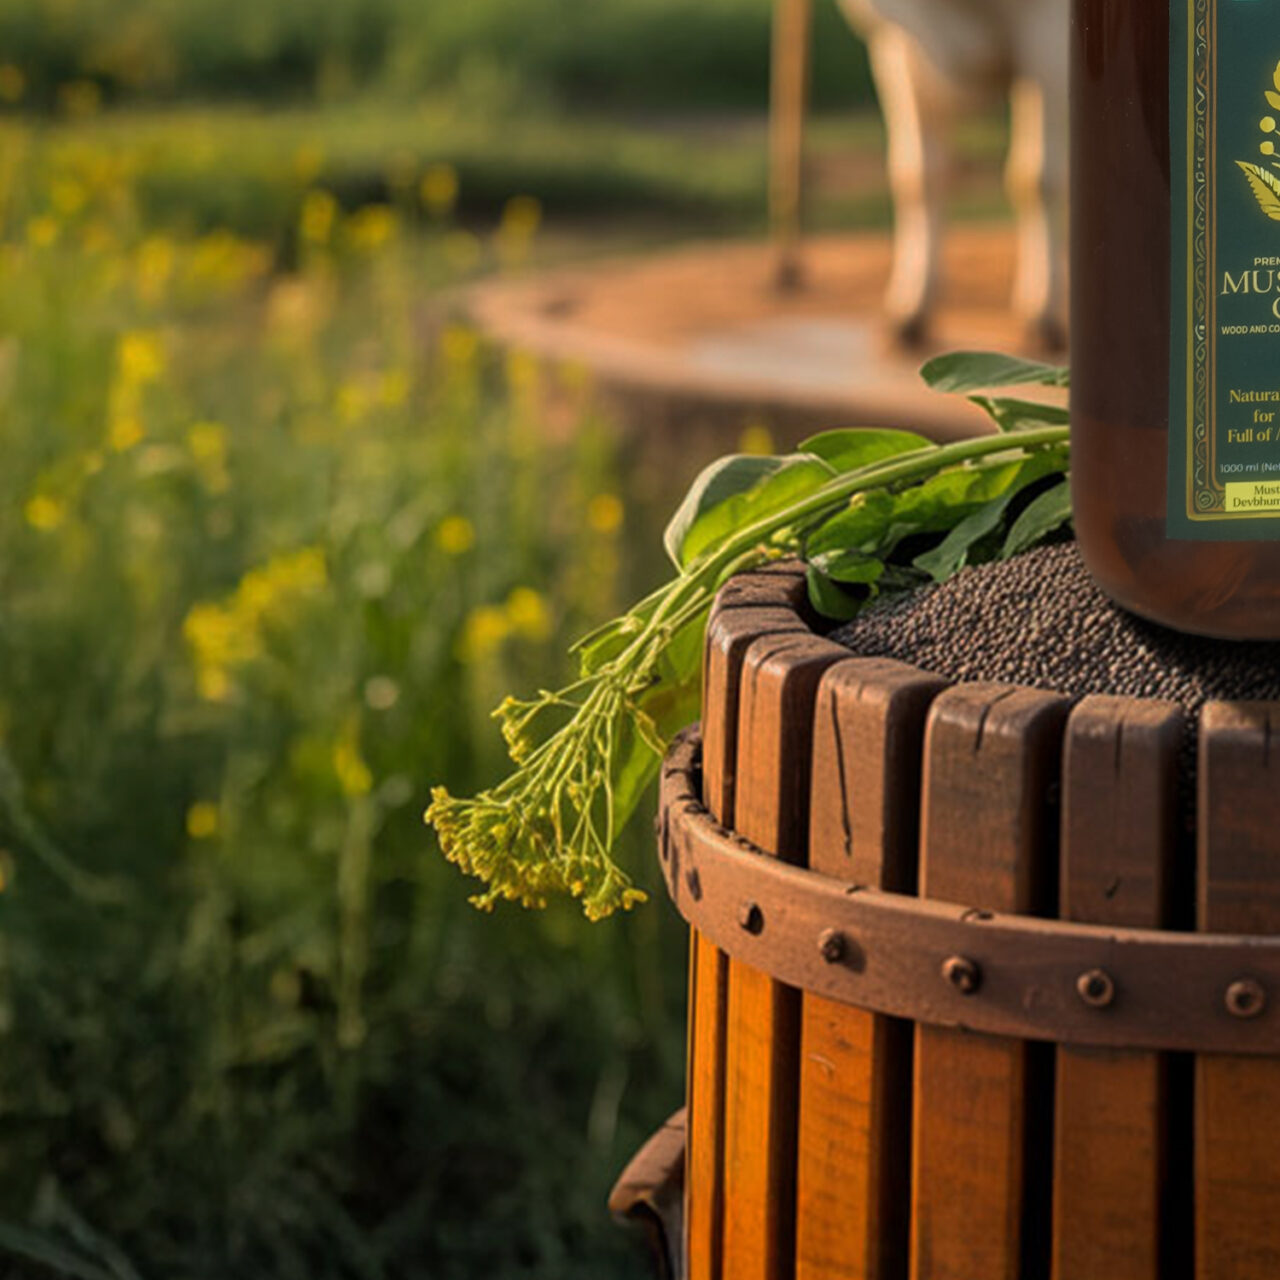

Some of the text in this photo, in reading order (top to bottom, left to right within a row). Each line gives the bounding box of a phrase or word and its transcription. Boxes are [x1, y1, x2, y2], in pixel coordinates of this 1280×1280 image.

[1221, 325, 1248, 335] WOOD
[1249, 324, 1267, 334] AND
[1253, 409, 1275, 423] for
[1227, 429, 1253, 443] Full
[1256, 427, 1272, 441] of
[1220, 464, 1243, 473] 1000
[1245, 463, 1259, 472] ml
